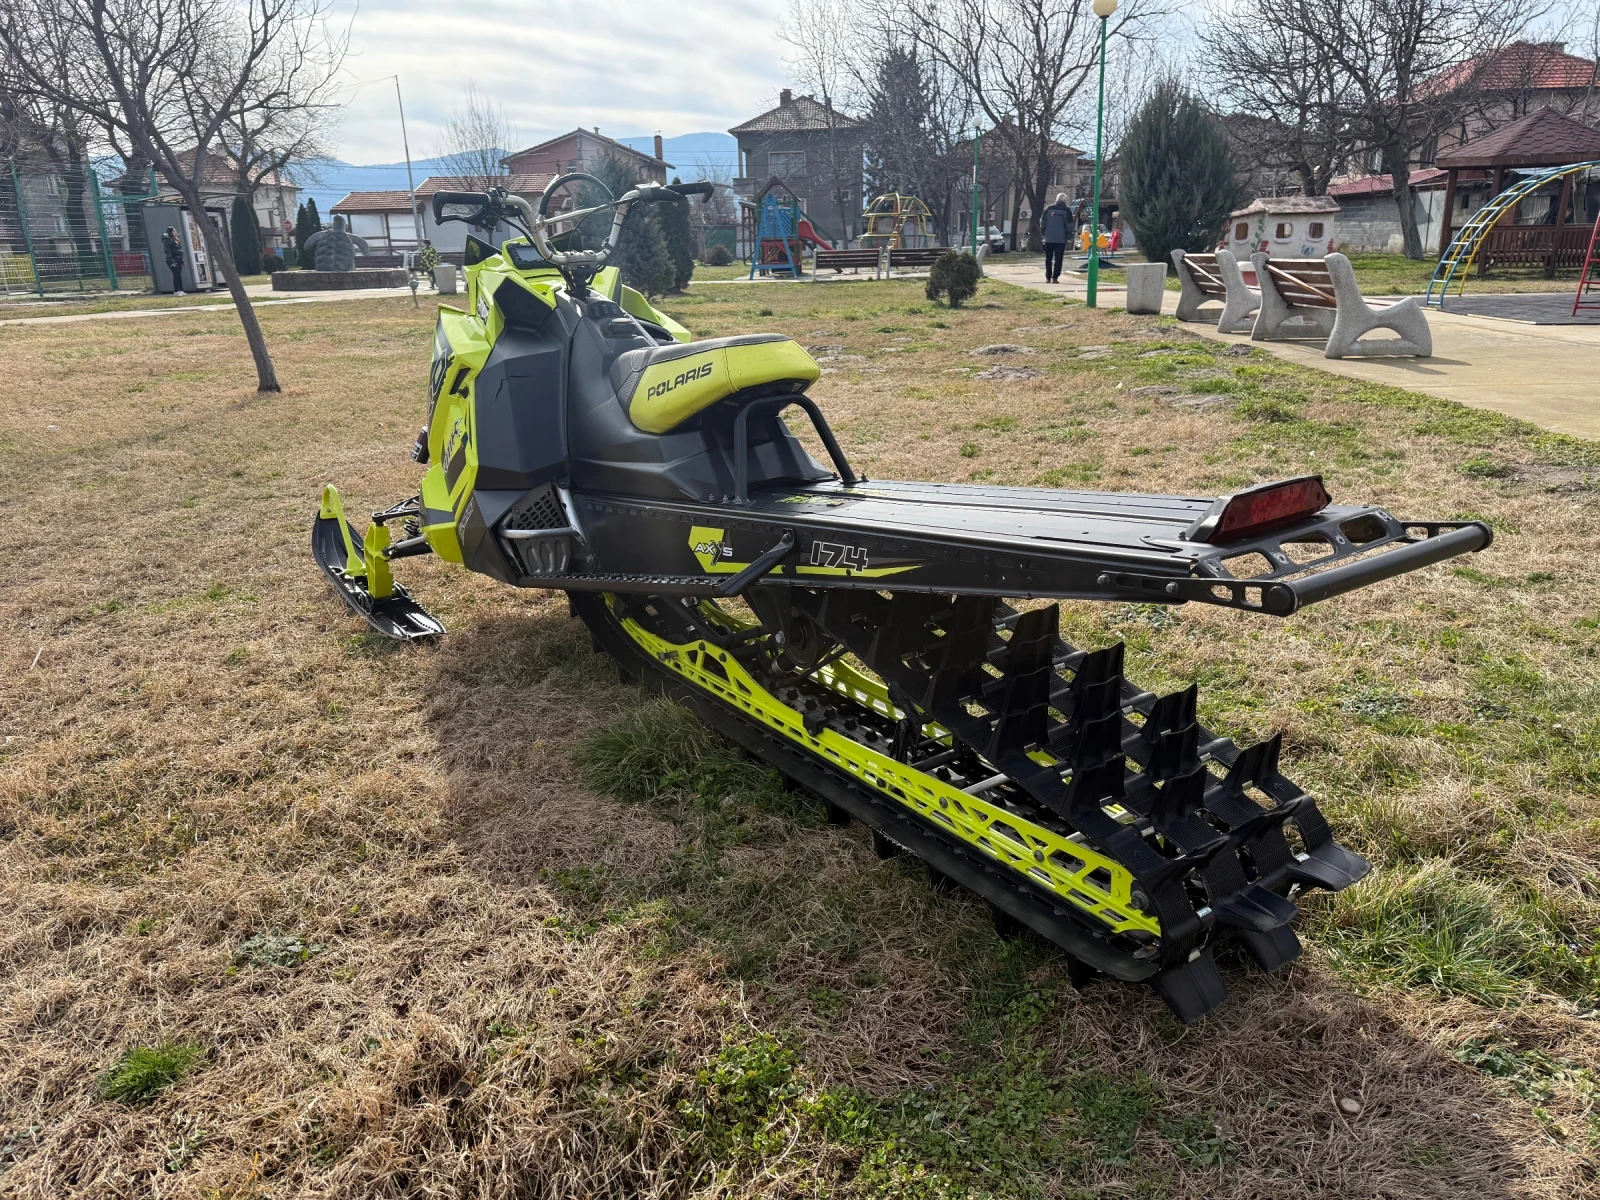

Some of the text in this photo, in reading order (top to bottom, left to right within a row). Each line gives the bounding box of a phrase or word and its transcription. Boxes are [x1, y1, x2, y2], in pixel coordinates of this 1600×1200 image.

[647, 362, 713, 401] POLARIS
[694, 539, 733, 566] AXYS
[810, 540, 869, 573] 174
